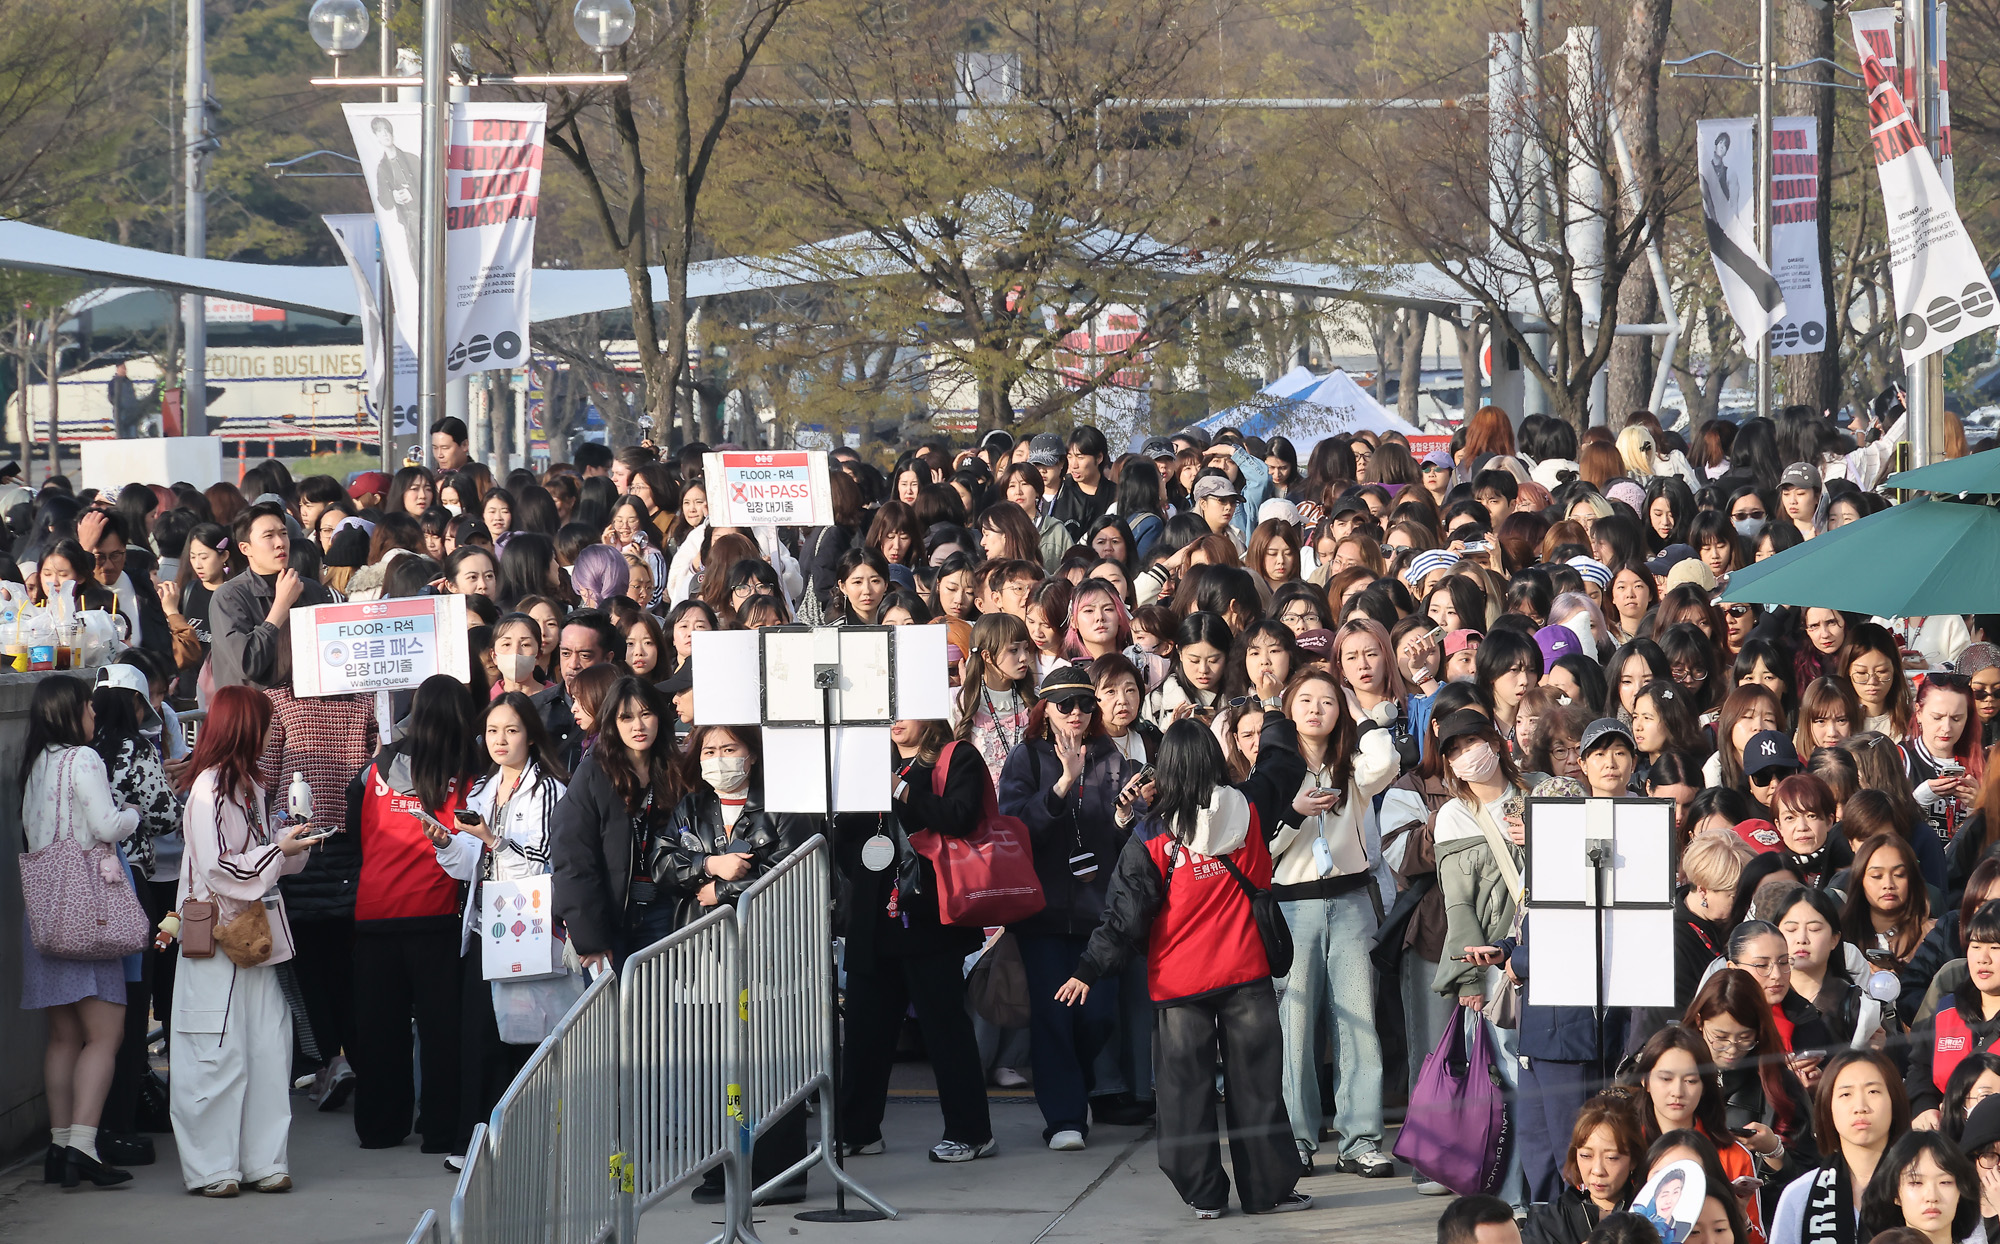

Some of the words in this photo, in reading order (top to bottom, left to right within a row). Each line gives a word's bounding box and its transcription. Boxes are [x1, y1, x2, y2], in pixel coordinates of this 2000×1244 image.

[273, 353, 363, 376] BUSLINES
[740, 470, 771, 480] FLOOR
[779, 469, 794, 479] R석
[750, 484, 809, 498] IN-PASS
[746, 501, 763, 513] 입장
[765, 501, 794, 513] 대기줄
[338, 623, 384, 637] FLOOR
[394, 619, 414, 632] R석
[352, 640, 385, 659] 얼굴
[389, 637, 424, 657] 패스
[345, 660, 370, 677] 입장
[374, 658, 413, 676] 대기줄
[350, 678, 382, 688] Waiting
[383, 676, 409, 686] Queue
